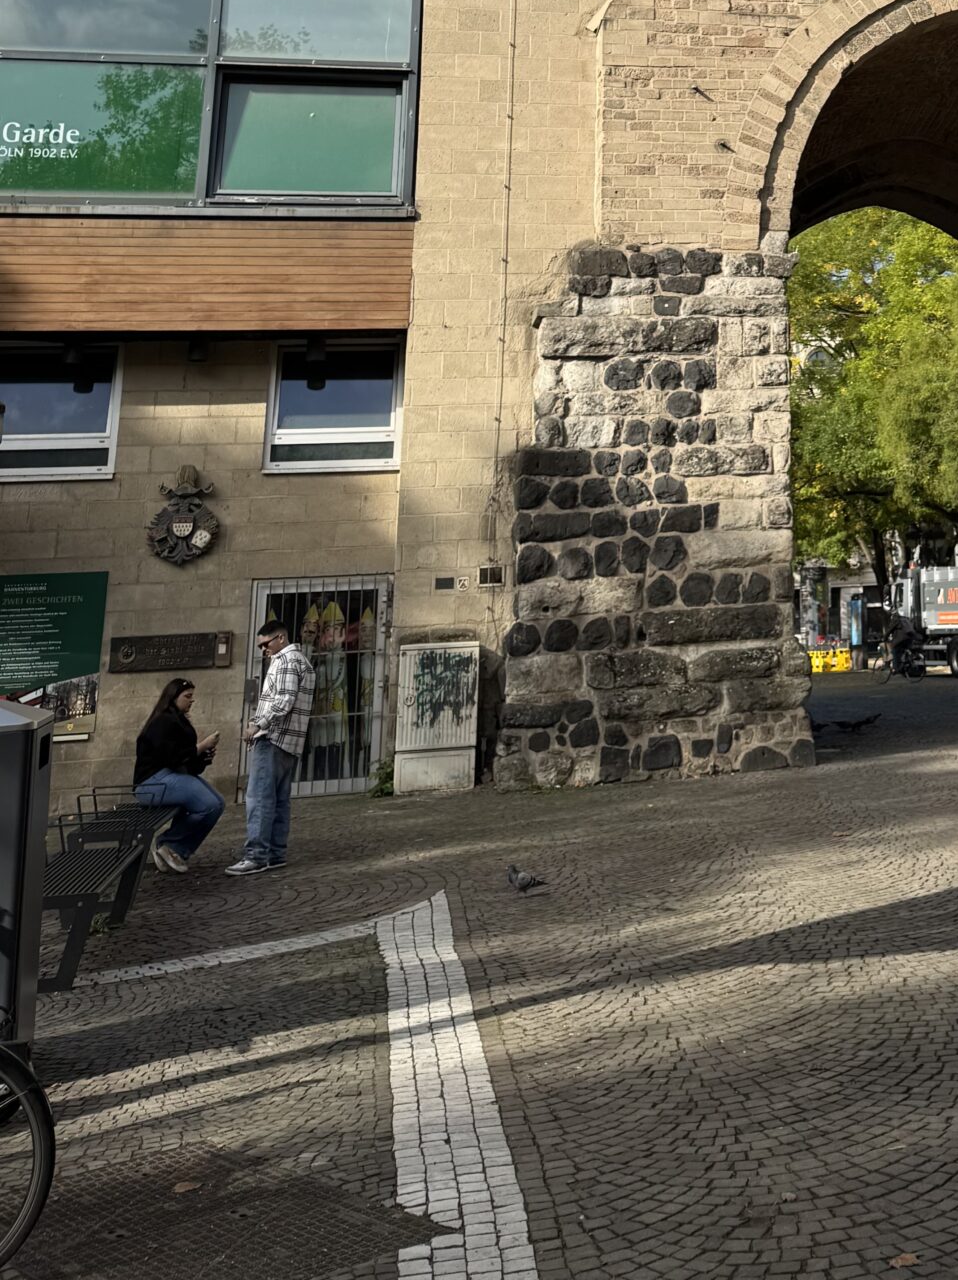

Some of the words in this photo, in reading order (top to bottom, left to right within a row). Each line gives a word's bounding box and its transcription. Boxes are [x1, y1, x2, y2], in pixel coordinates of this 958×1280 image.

[2, 121, 80, 144] Garde
[28, 148, 57, 158] 1902
[60, 148, 78, 159] E.V.
[1, 597, 24, 606] ZWEI
[25, 595, 84, 605] GESCHICHTEN
